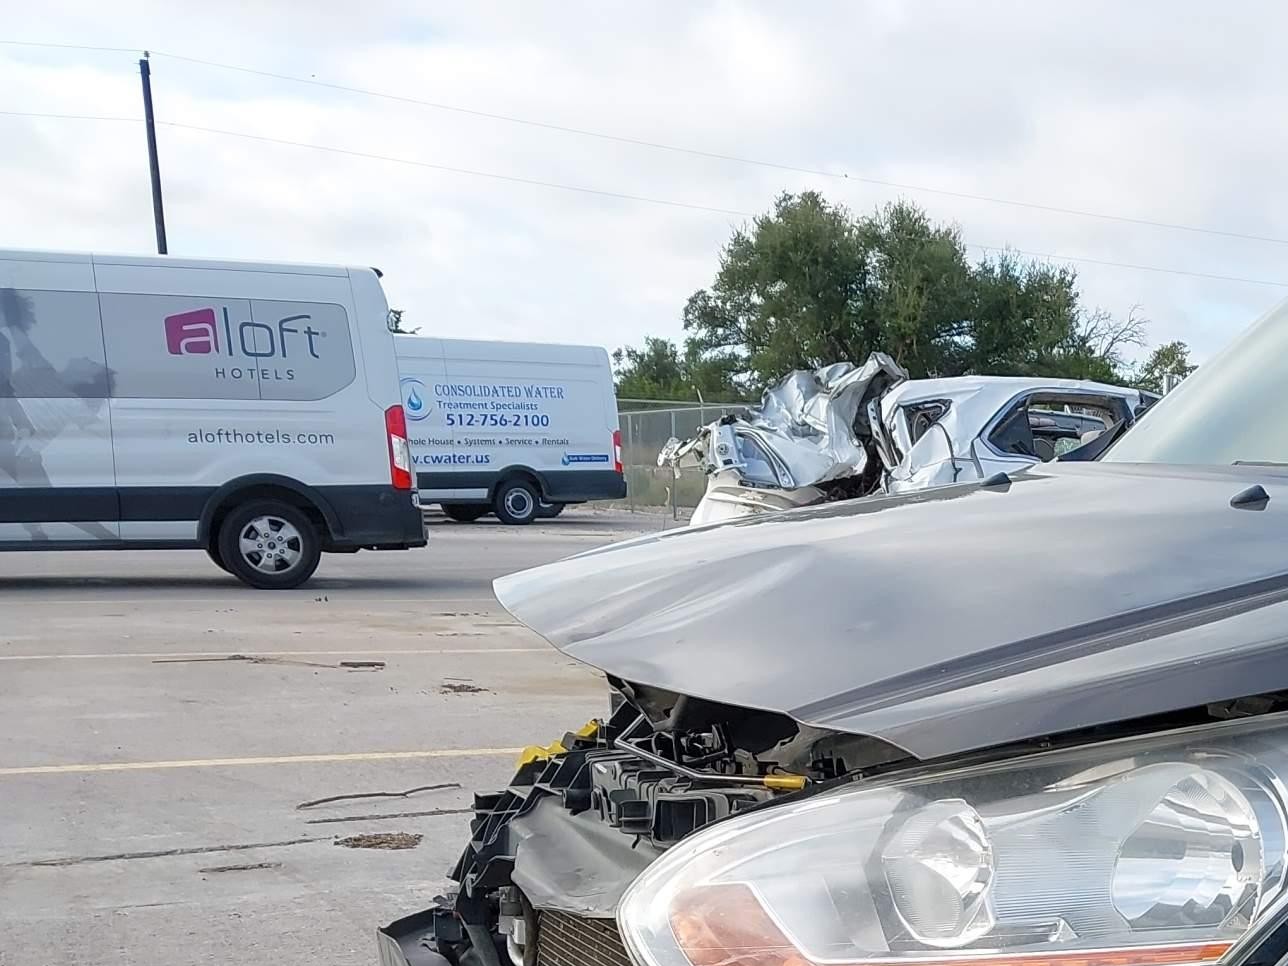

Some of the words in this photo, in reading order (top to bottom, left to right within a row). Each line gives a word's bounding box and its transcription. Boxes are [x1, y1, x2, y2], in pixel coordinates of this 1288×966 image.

[164, 306, 320, 359] aloft
[215, 367, 295, 380] HOTELS
[435, 384, 521, 398] CONSOLIDATED
[524, 385, 565, 399] WATER
[437, 400, 488, 410] Treatment
[490, 401, 538, 411] Specialists
[446, 413, 549, 427] 512-756-2100
[187, 428, 335, 445] alofthotels.com
[406, 437, 426, 445] hole
[428, 437, 454, 446] House
[464, 437, 496, 447] Systems
[505, 437, 533, 446] Service
